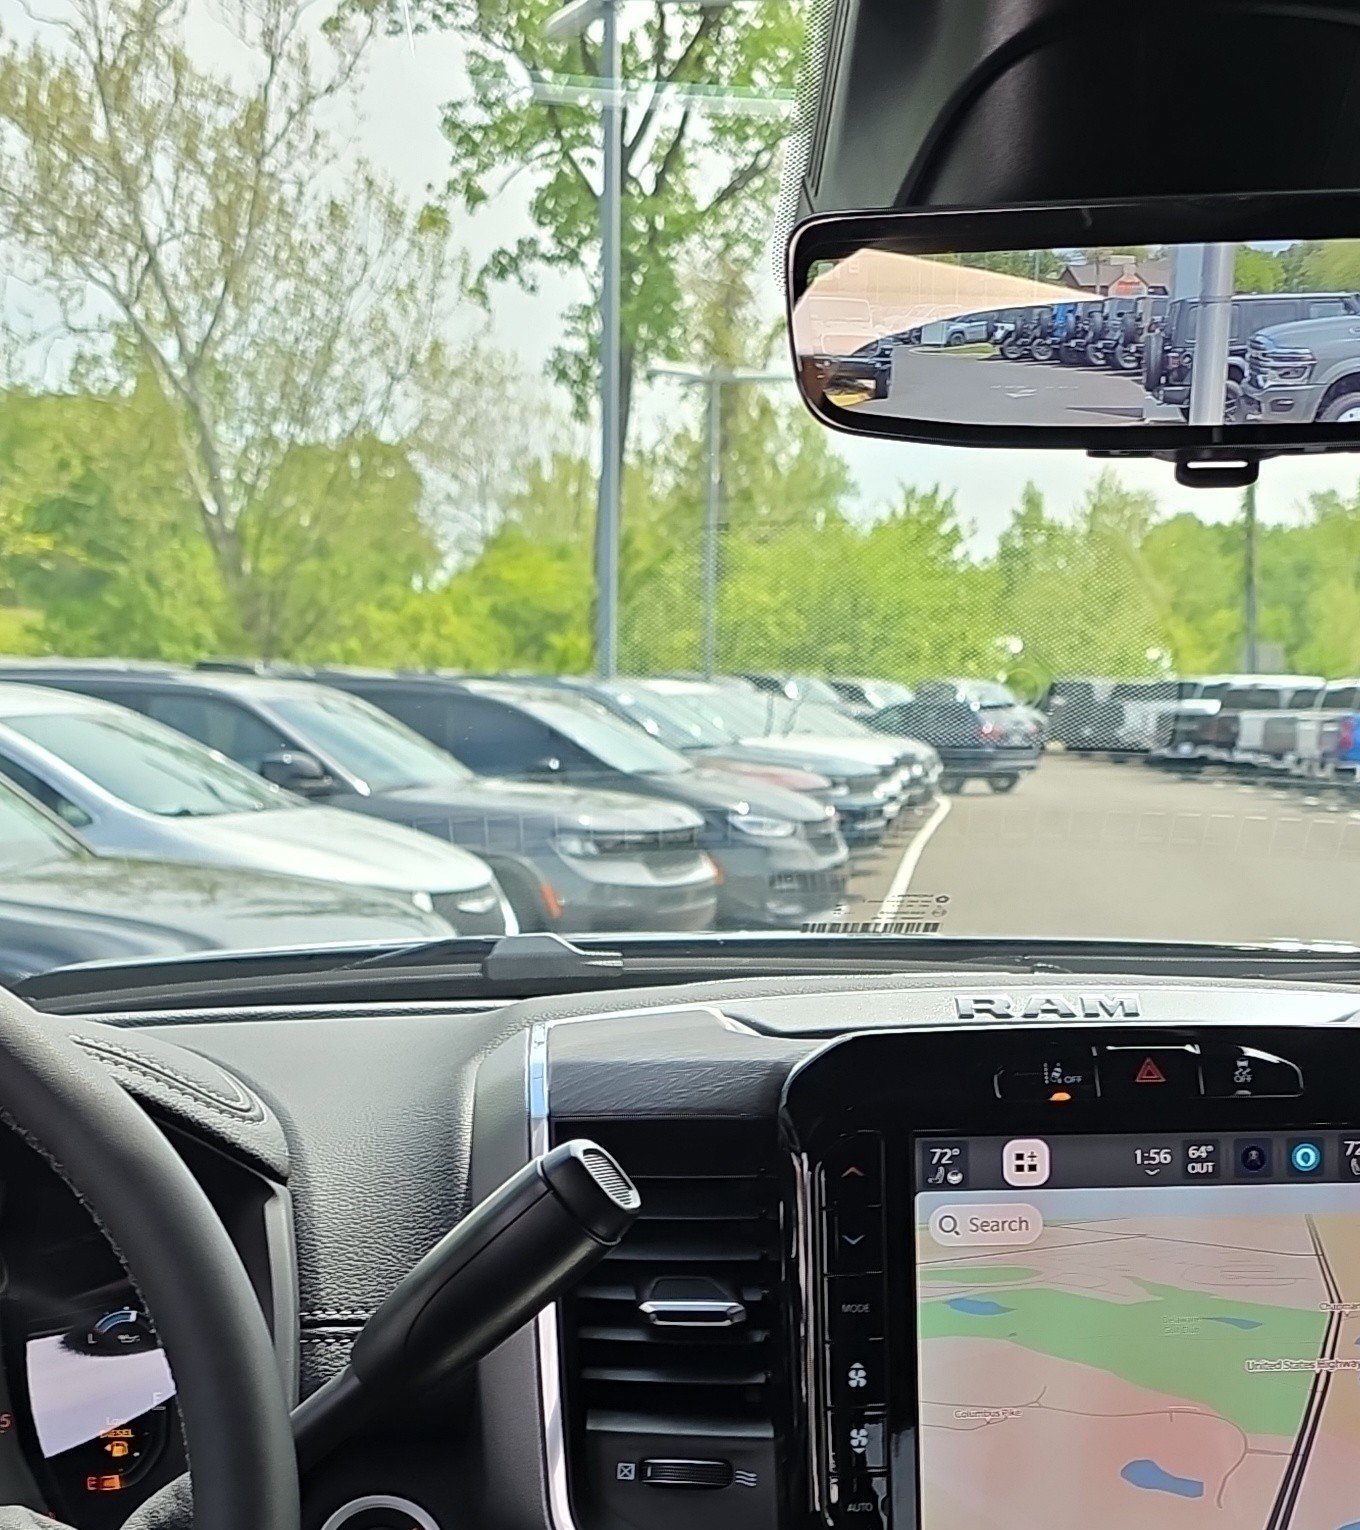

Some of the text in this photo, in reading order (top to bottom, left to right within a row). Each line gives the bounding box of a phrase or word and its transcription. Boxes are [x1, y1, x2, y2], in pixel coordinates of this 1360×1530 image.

[954, 993, 1141, 1019] RAM
[1064, 1075, 1082, 1084] OFF
[930, 1148, 961, 1165] 72°
[1134, 1149, 1172, 1165] 1:56
[1188, 1145, 1214, 1160] 64°
[1187, 1162, 1215, 1174] OUT
[969, 1217, 1030, 1233] Search
[842, 1304, 870, 1313] MODE
[87, 1333, 95, 1344] L
[1246, 1359, 1279, 1371] United
[1281, 1359, 1315, 1371] States
[955, 1408, 1000, 1419] Columbus
[0, 1412, 11, 1428] 5
[847, 1502, 873, 1512] AUTO
